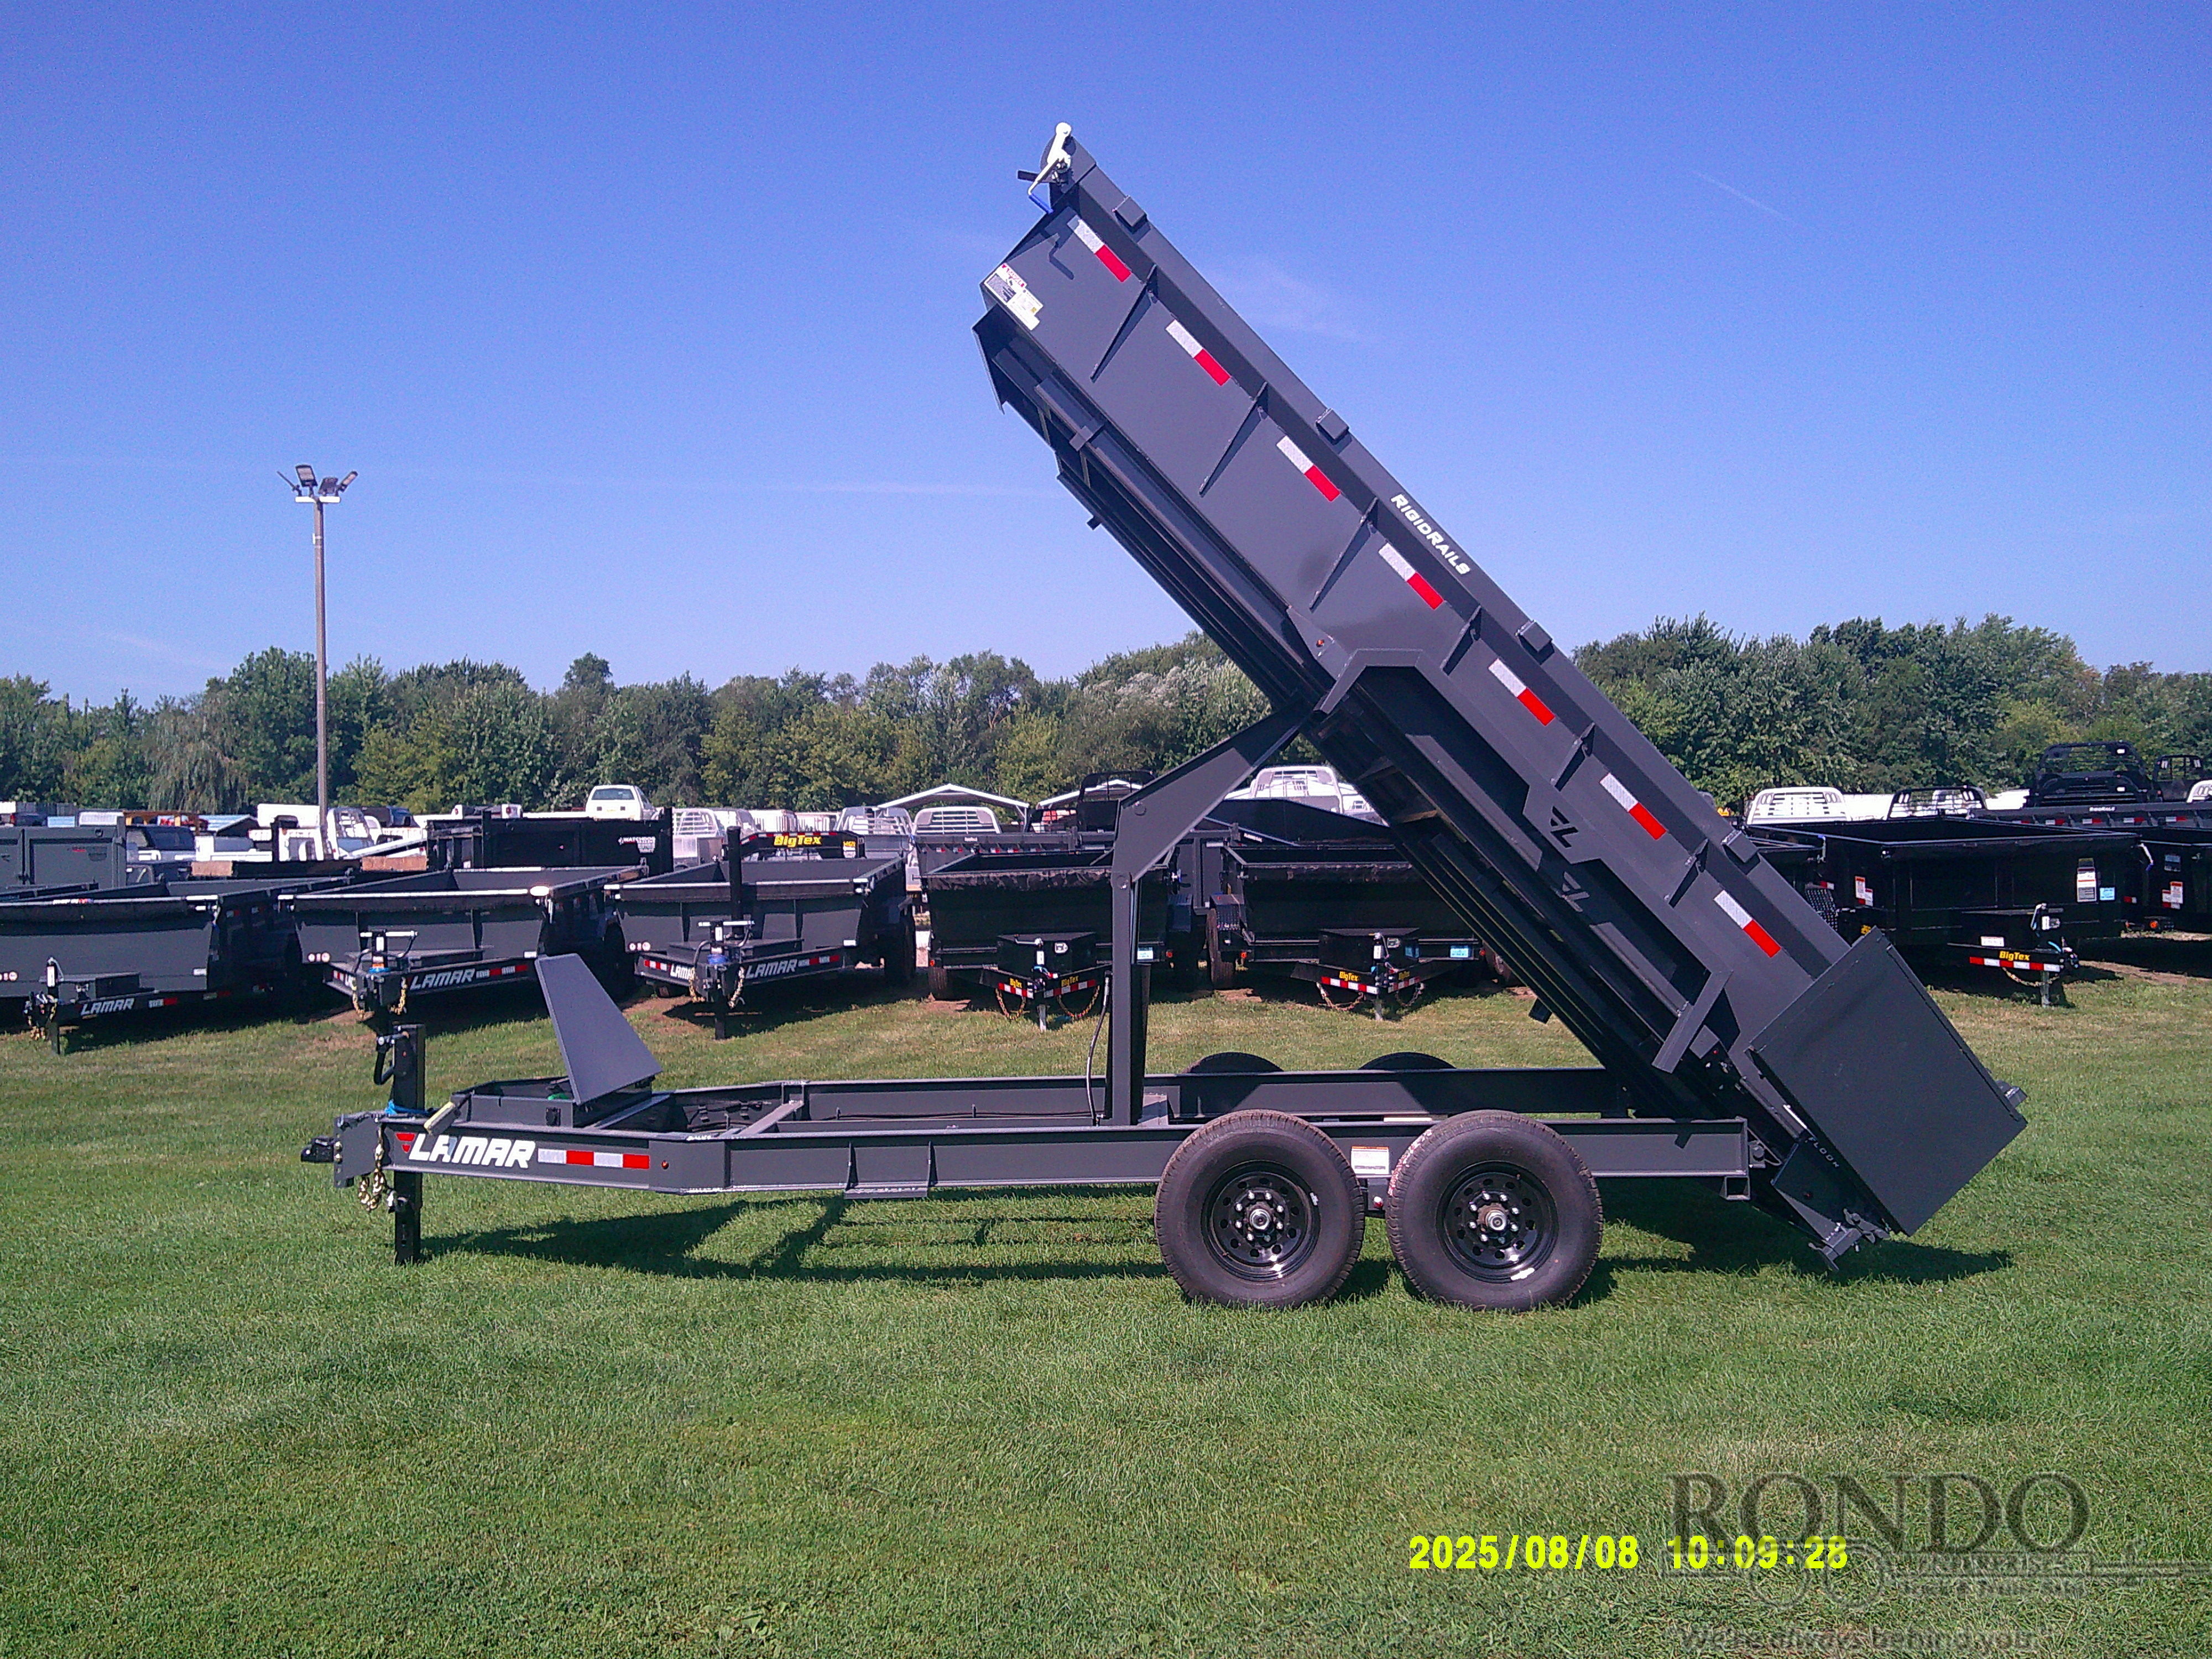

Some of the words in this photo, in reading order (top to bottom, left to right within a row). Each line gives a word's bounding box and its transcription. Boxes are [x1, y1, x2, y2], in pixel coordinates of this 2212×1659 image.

[774, 835, 822, 847] BigTex
[1999, 951, 2031, 961] BigTex
[747, 959, 798, 979] LAMAR
[410, 968, 475, 990] LAMAR
[81, 998, 135, 1015] LAMAR
[409, 1134, 536, 1168] LAMAR
